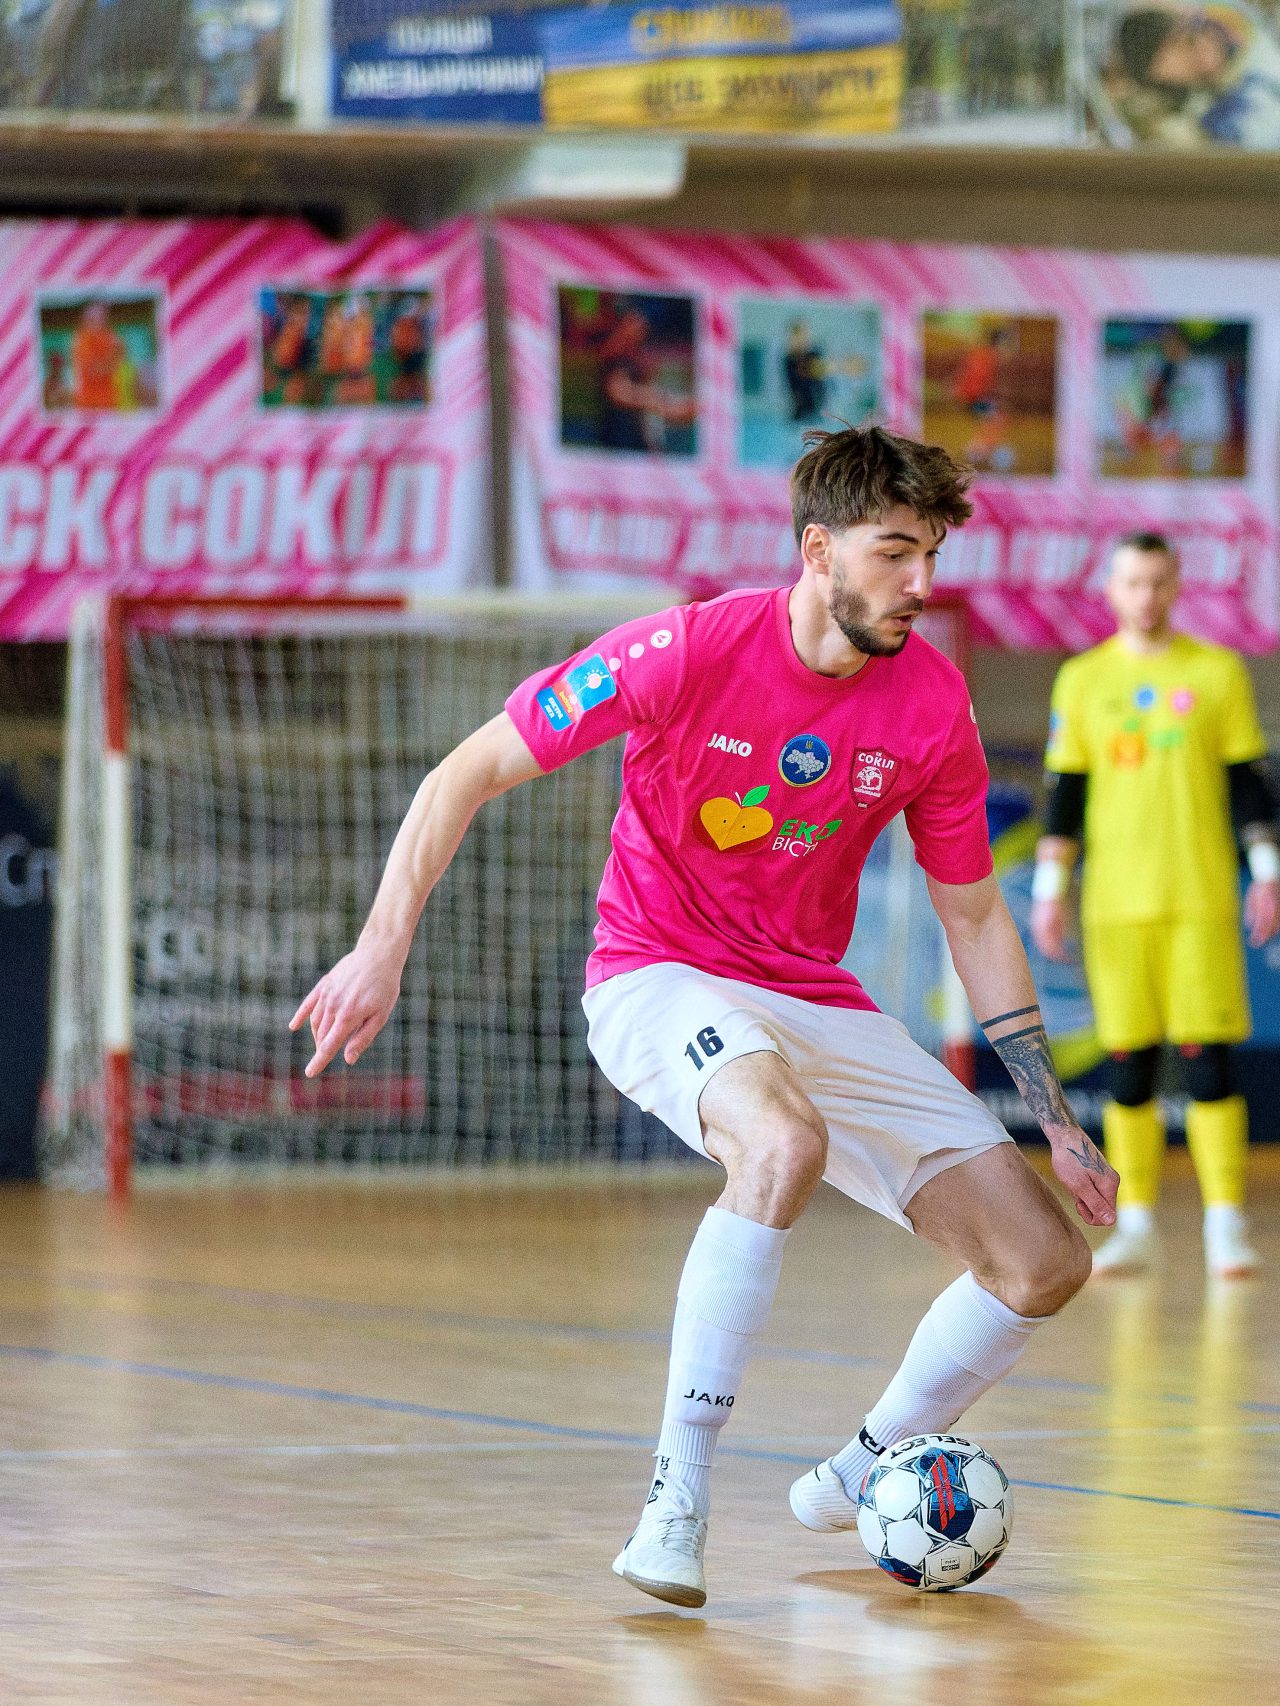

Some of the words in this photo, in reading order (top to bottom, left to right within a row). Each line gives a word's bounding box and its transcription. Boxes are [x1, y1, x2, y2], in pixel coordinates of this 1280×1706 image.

[140, 463, 441, 565] СОКІЛ
[707, 733, 753, 757] JAKO
[858, 752, 895, 770] СОКІЛ
[684, 1025, 725, 1072] 16
[684, 1388, 735, 1408] JAKO
[890, 1435, 971, 1460] SELECT
